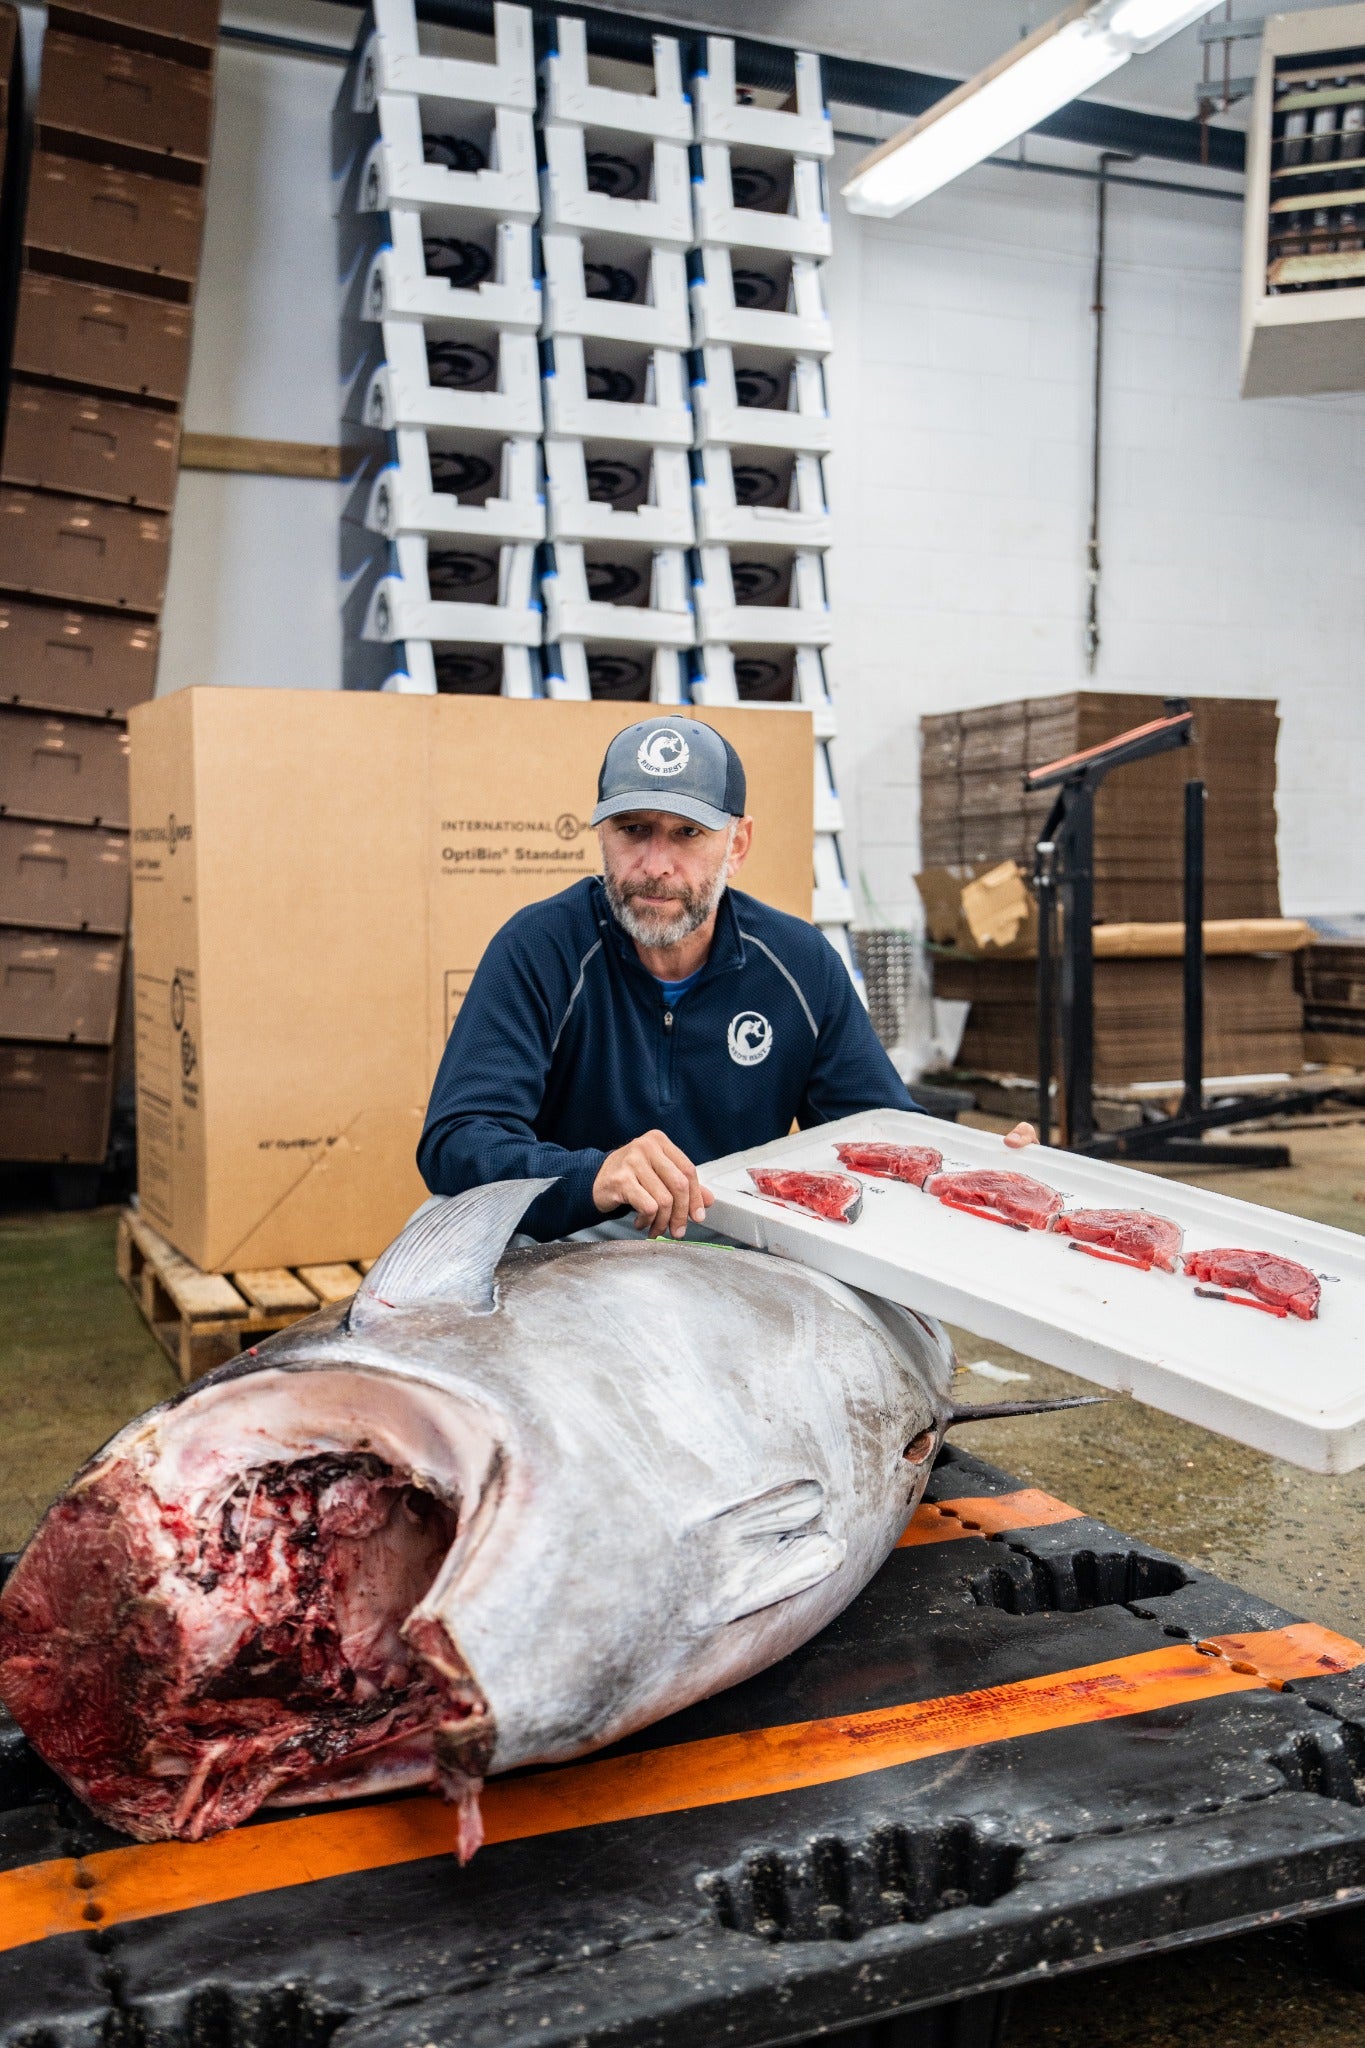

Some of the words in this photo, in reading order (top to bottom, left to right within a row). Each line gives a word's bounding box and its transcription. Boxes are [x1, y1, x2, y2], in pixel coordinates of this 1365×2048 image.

[641, 760, 661, 773] RED'S
[663, 763, 682, 774] BEST
[441, 820, 553, 832] INTERNATIONAL
[515, 847, 585, 861] Standard
[921, 1681, 1028, 1711] WARNING
[864, 1715, 912, 1730] POSTAL
[913, 1705, 962, 1720] SERVICE
[961, 1698, 994, 1711] USES
[994, 1684, 1062, 1704] ELECTRONIC
[931, 1715, 948, 1724] TO
